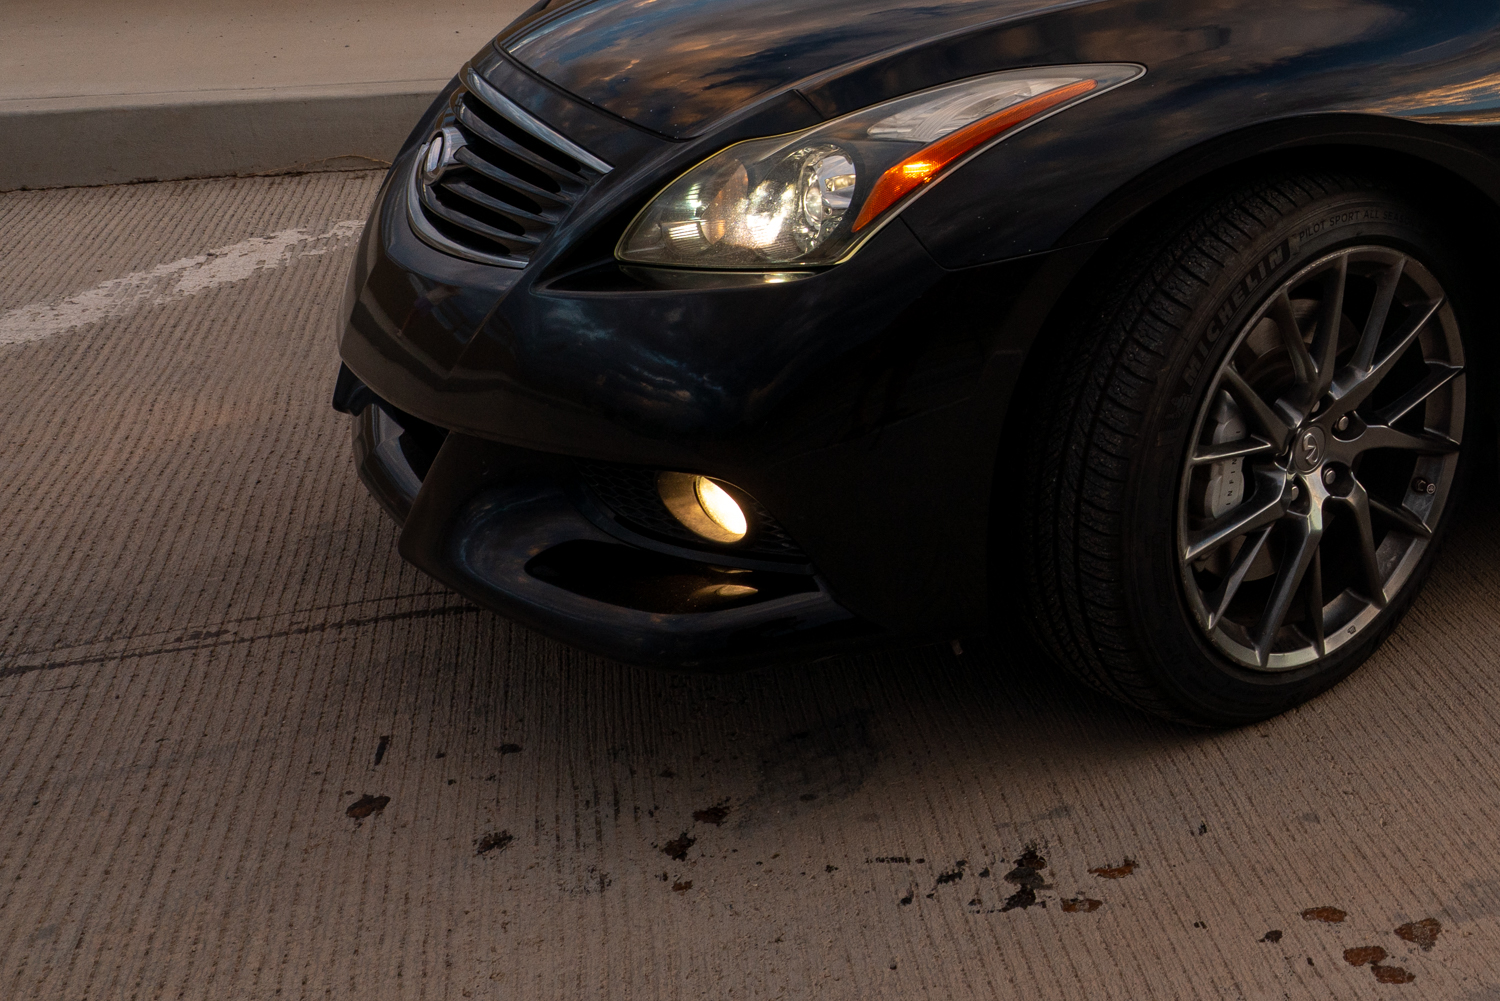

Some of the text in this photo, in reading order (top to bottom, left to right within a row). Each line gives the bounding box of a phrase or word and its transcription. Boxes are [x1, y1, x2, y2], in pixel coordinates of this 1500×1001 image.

[1181, 244, 1285, 387] MICHELIN
[1299, 220, 1327, 242] PILOT
[1329, 210, 1360, 227] SPORT
[1363, 210, 1380, 219] ALL
